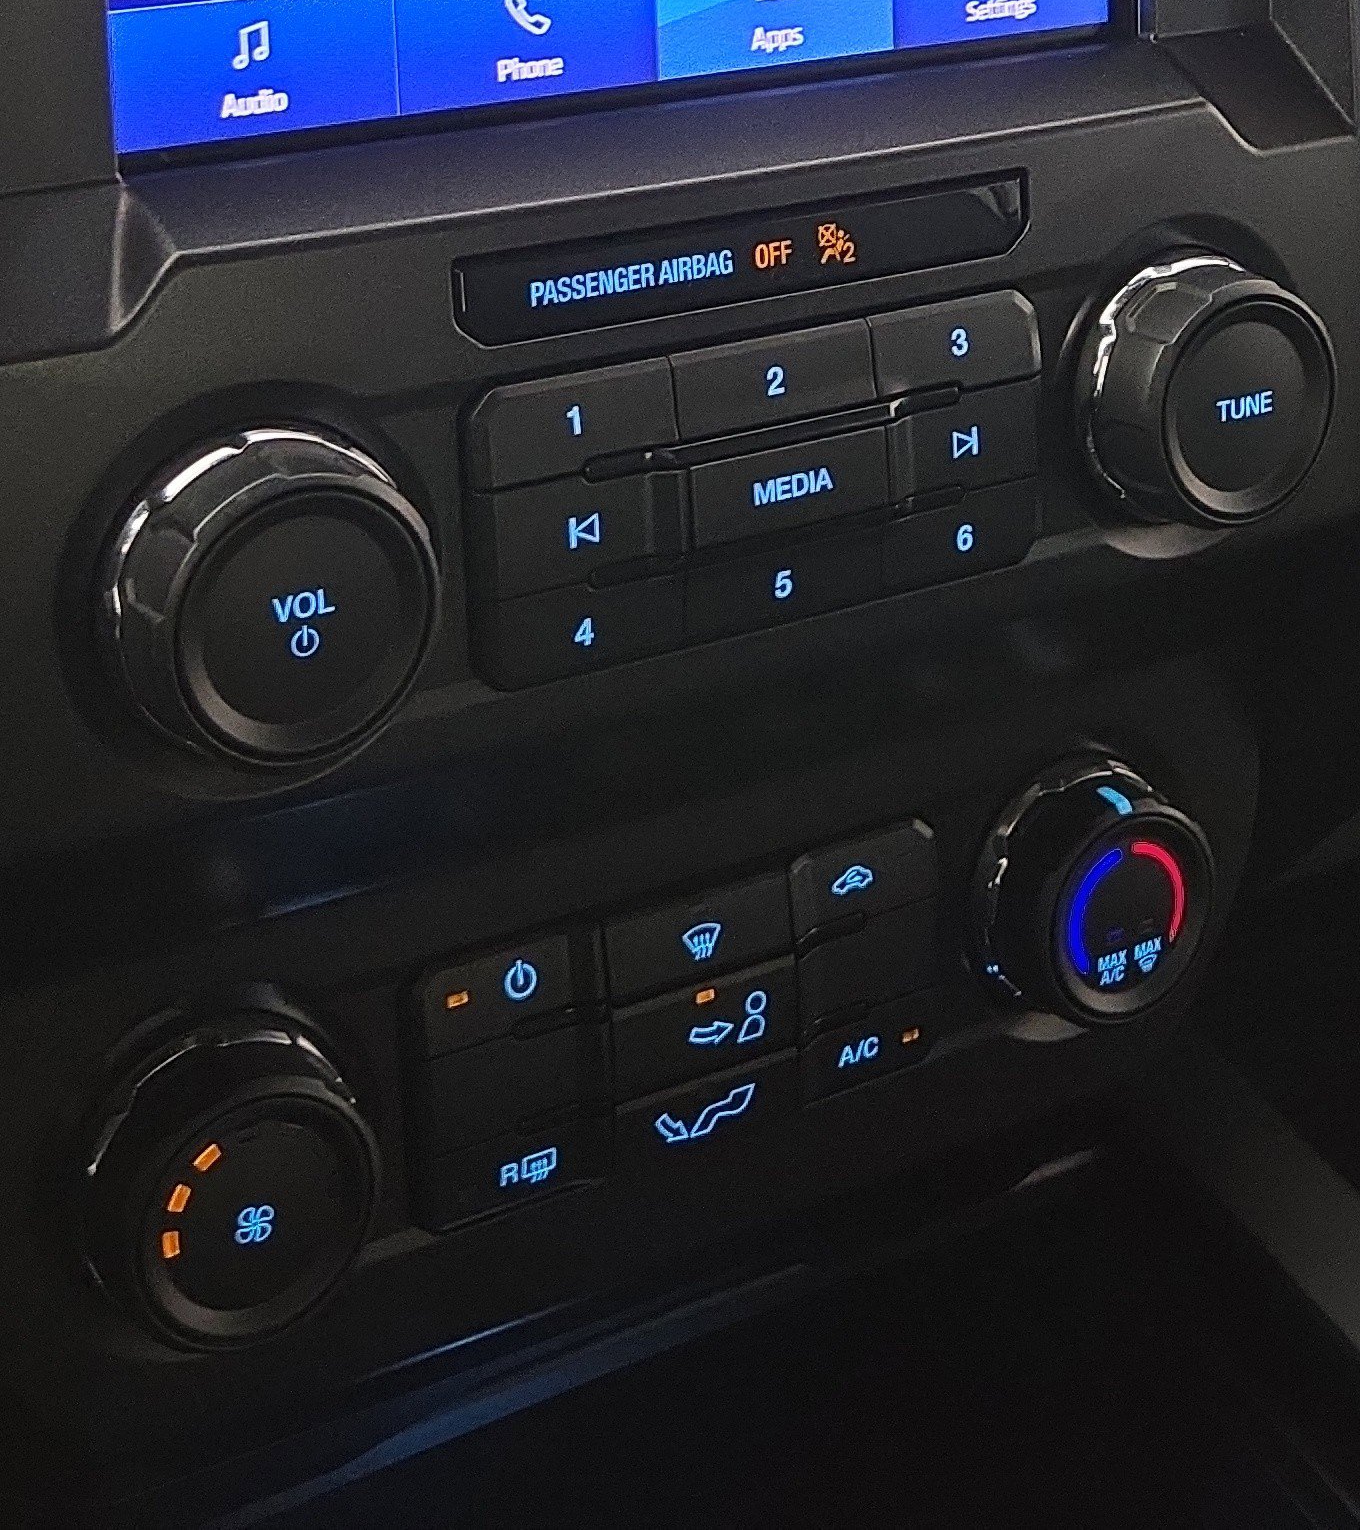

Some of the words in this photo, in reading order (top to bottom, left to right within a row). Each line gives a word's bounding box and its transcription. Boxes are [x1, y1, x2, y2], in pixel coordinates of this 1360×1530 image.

[750, 25, 804, 54] Apps
[496, 57, 564, 83] Phone
[219, 88, 289, 119] Audio
[529, 266, 656, 308] PASSENGER
[657, 249, 734, 286] AIRBAG
[753, 239, 792, 269] OFF
[950, 328, 969, 358] 3
[766, 366, 786, 397] 2
[566, 405, 582, 436] 1
[1215, 390, 1274, 422] TUNE
[753, 467, 834, 506] MEDIA
[956, 524, 974, 553] 6
[774, 569, 793, 600] 5
[271, 588, 336, 623] VOL
[574, 617, 595, 647] 4
[1096, 948, 1128, 972] MAX
[1133, 936, 1162, 961] MAX
[1098, 965, 1125, 986] A/C
[837, 1036, 880, 1068] A/C
[499, 1162, 520, 1188] R
